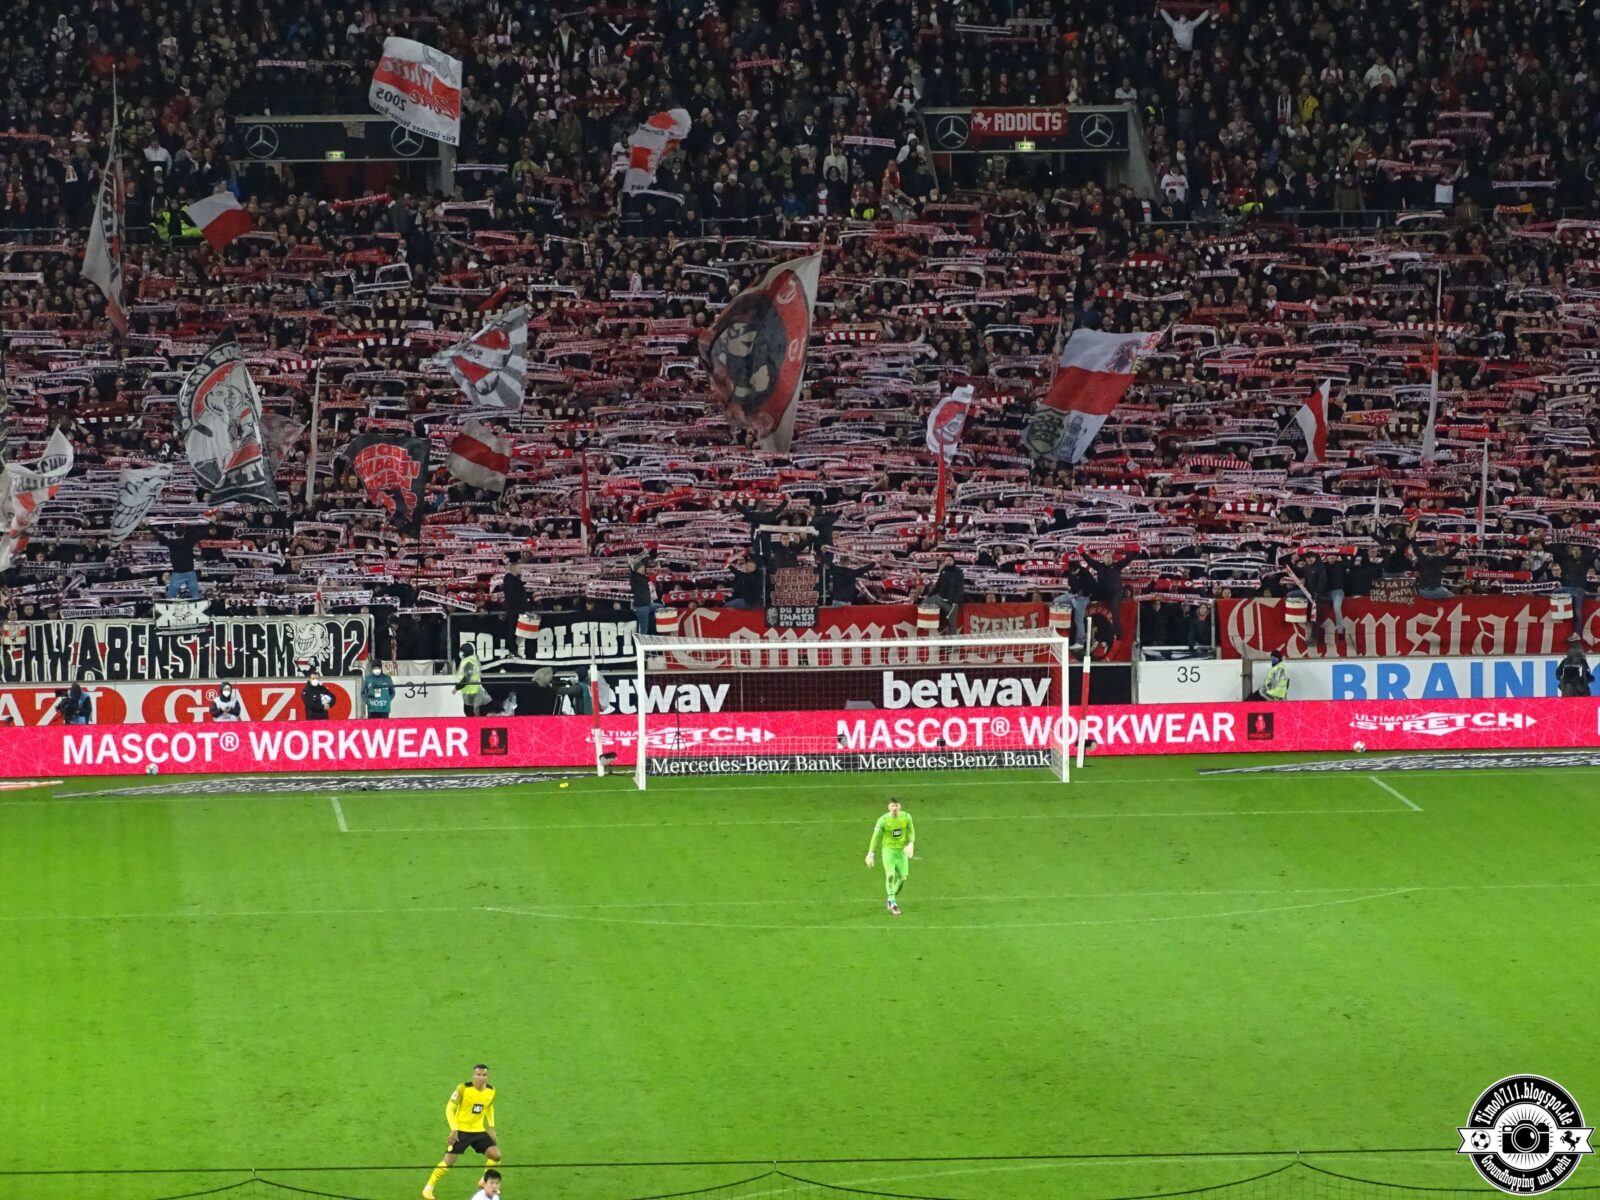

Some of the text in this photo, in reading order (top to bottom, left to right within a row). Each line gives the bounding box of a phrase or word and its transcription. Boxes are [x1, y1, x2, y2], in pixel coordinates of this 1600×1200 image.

[994, 112, 1063, 132] ADDICTS
[594, 591, 635, 601] COMMAN
[780, 613, 815, 621] IMMER
[969, 615, 1025, 634] SZENE
[320, 620, 366, 678] 02
[536, 621, 638, 660] BLEIBT
[1177, 666, 1201, 683] 35
[404, 682, 428, 699] 34
[883, 671, 1052, 710] betway
[1019, 711, 1236, 746] WORKWEAR
[1350, 711, 1524, 733] STRETCH
[249, 727, 470, 762] WORKWEAR
[651, 755, 843, 775] Mercedes-Benz Bank
[858, 751, 1050, 771] Mercedes-Benz Bank
